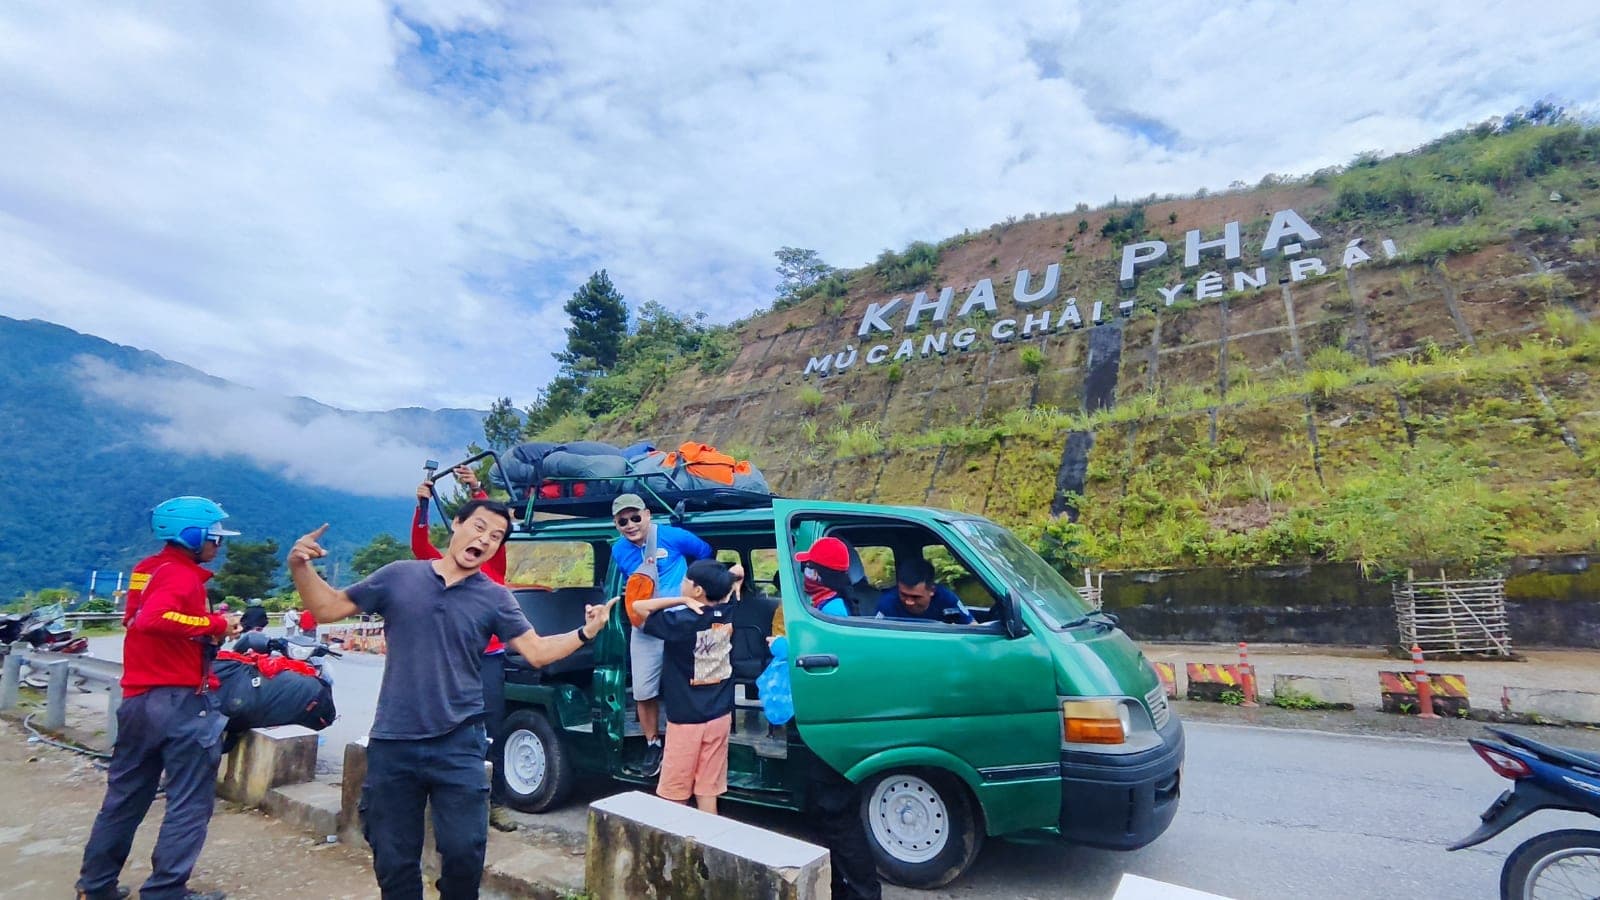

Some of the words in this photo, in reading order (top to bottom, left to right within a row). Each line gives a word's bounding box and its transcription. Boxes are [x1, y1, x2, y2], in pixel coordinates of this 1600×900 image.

[803, 345, 858, 377] MÙ
[865, 328, 977, 364] CANG
[1156, 267, 1267, 306] YÊN
[858, 263, 1061, 337] KHAU
[1119, 209, 1322, 283] PHẠ
